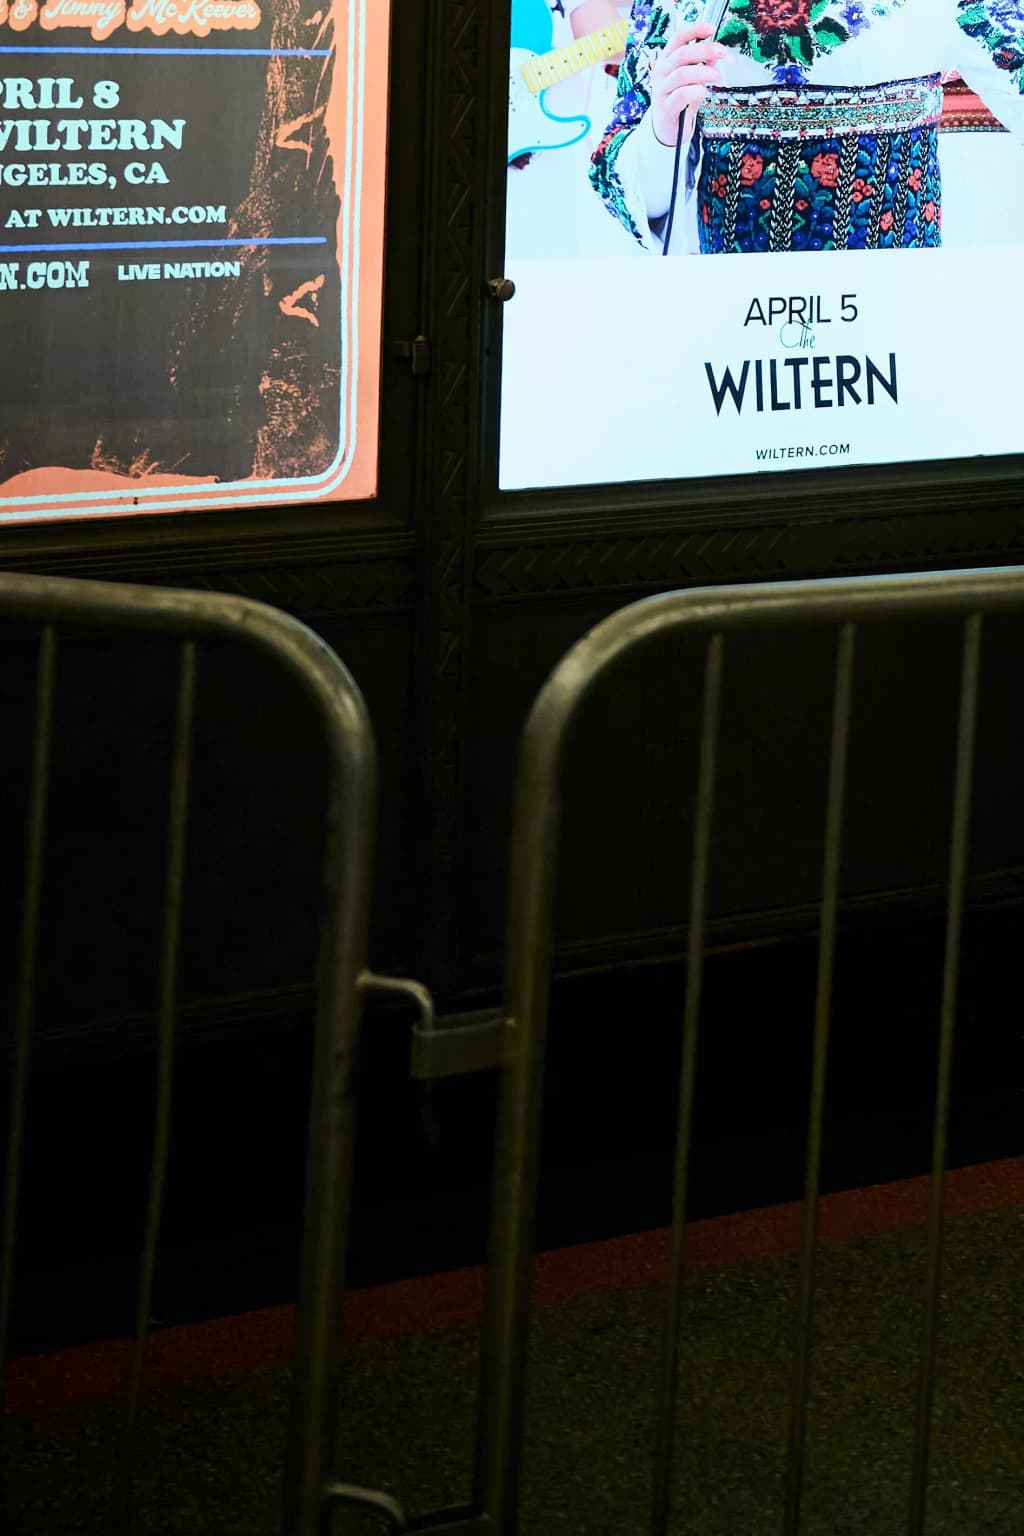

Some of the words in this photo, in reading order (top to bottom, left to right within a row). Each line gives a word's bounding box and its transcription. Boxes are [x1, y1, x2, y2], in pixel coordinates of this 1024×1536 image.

[0, 76, 84, 111] RIL
[92, 79, 121, 110] 8
[0, 161, 118, 191] GELES,
[123, 161, 171, 186] CA
[4, 208, 43, 229] AT
[47, 204, 228, 228] WILTERN.COM
[117, 263, 161, 282] LIVE
[164, 261, 242, 280] NATION
[743, 294, 833, 327] APRIL
[840, 293, 859, 323] 5
[703, 351, 899, 417] WILTERN
[755, 443, 851, 461] WILTERN.COM
